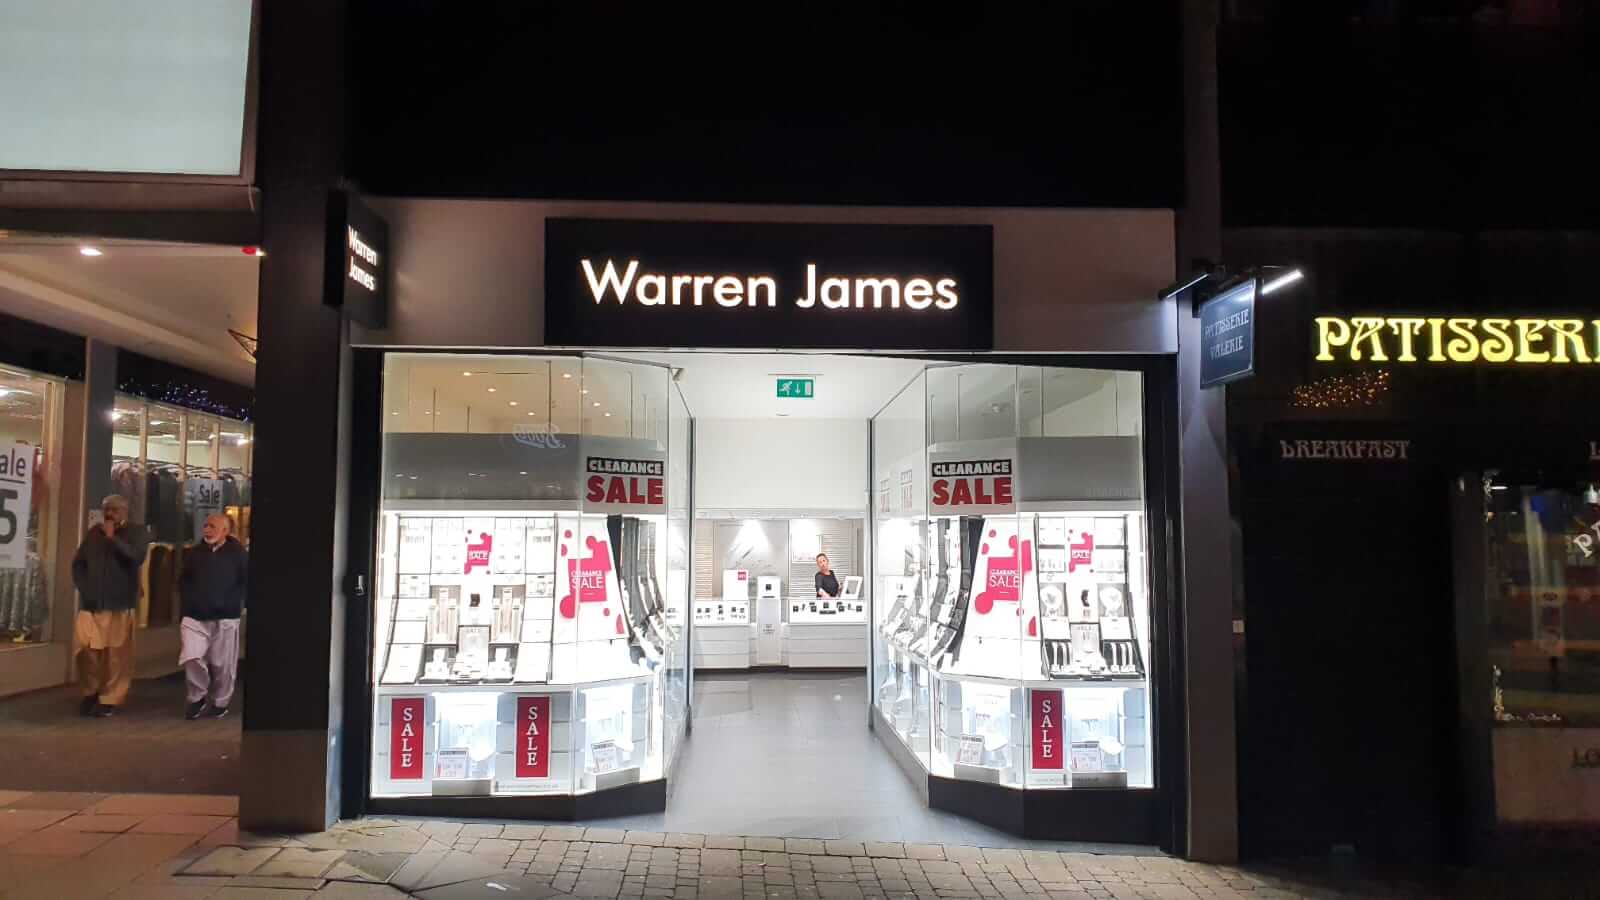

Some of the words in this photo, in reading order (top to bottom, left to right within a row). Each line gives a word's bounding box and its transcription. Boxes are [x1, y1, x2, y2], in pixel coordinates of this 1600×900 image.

[347, 224, 377, 267] Warren
[349, 255, 375, 291] James
[581, 259, 776, 307] Warren
[795, 264, 959, 309] James
[589, 459, 662, 474] CLEARANCE
[933, 461, 1010, 476] CLEARANCE
[200, 483, 220, 504] Sale
[586, 475, 664, 504] SALE
[932, 477, 1013, 506] SALE
[572, 577, 603, 590] SALE
[990, 575, 1020, 588] SALE
[401, 707, 415, 768] SALE
[526, 706, 539, 766] SALE
[1041, 699, 1054, 759] SALE
